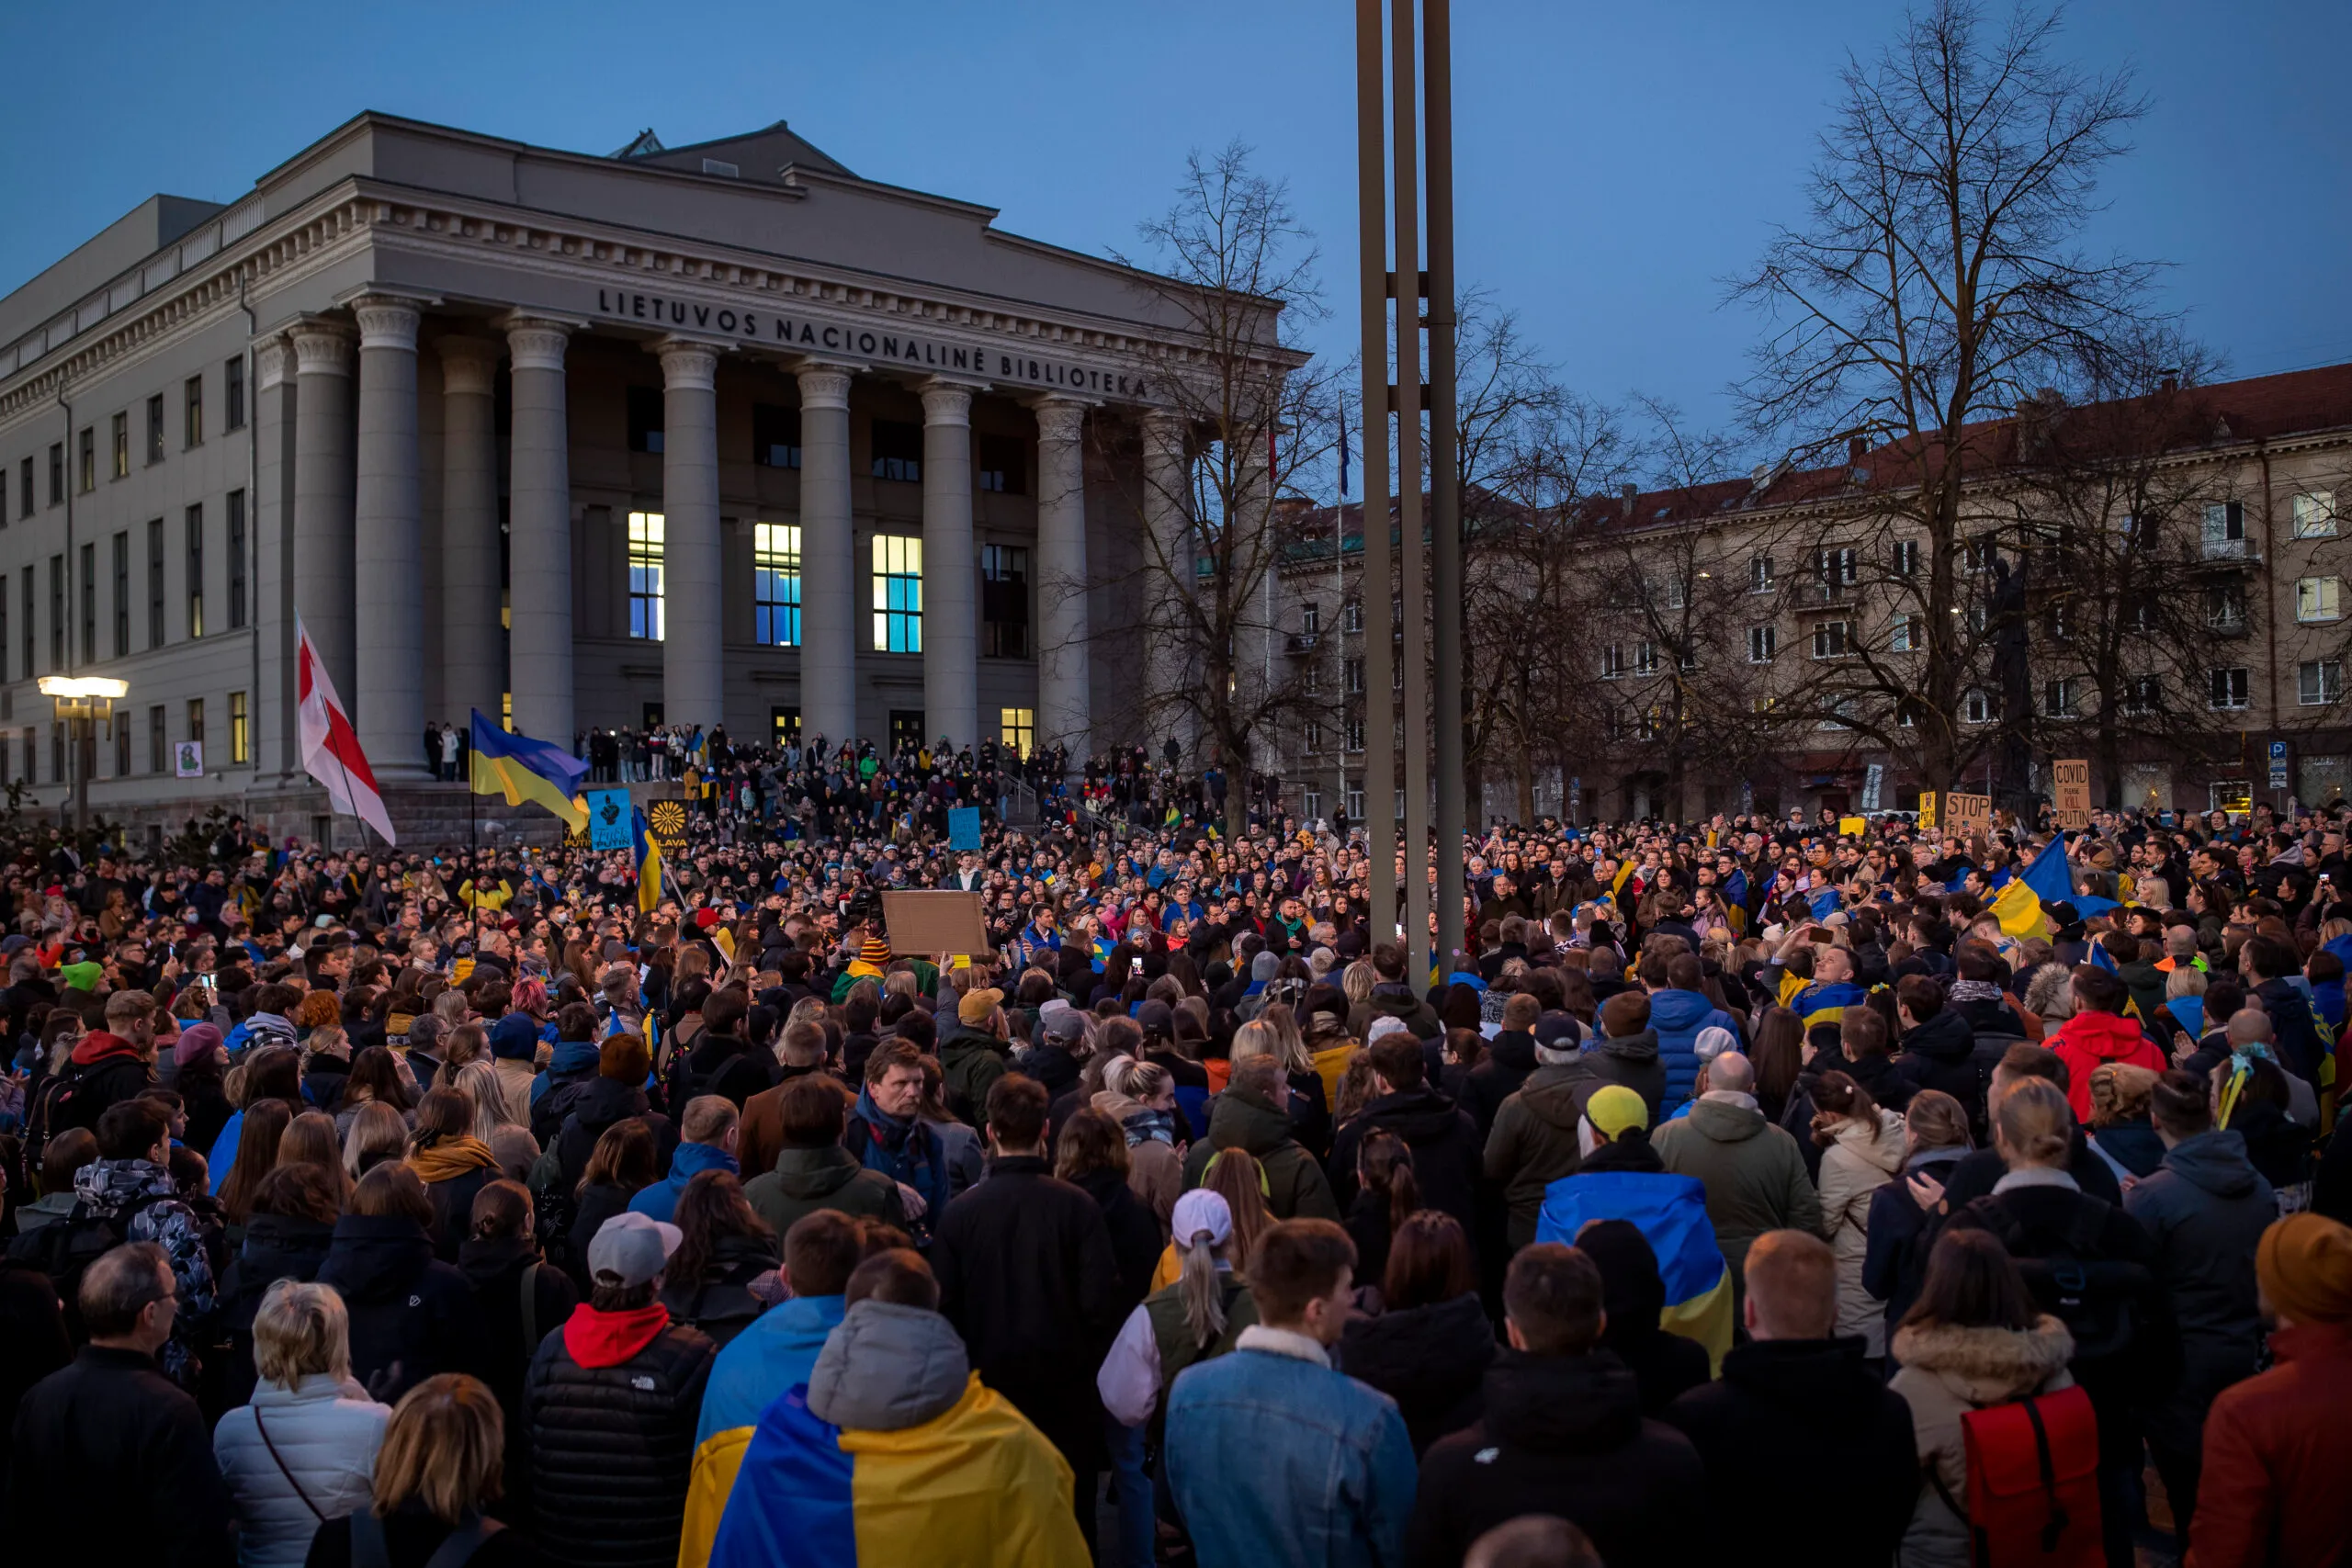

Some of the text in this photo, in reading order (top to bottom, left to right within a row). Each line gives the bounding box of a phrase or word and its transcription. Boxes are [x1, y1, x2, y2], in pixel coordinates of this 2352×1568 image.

[600, 289, 1147, 398] LIETUVOS NACIONALINĖ BIBLIOTEKA
[2273, 743, 2283, 757] P
[2056, 763, 2086, 784] COVID
[1948, 795, 1990, 818] STOP
[2064, 796, 2081, 809] KILL
[2058, 809, 2090, 825] PUTIN
[595, 839, 630, 848] PUTIN
[653, 839, 687, 847] LAVA
